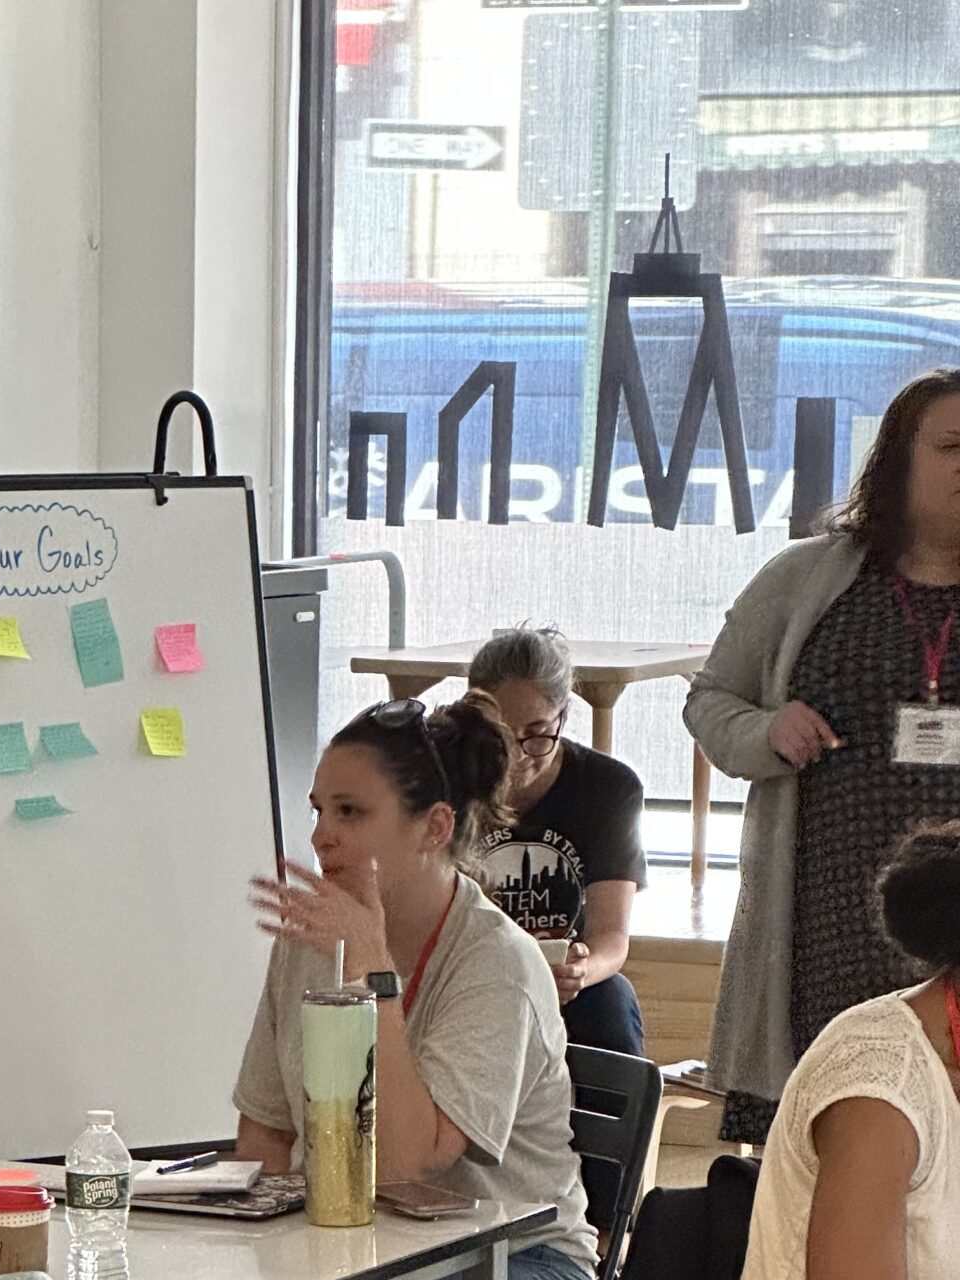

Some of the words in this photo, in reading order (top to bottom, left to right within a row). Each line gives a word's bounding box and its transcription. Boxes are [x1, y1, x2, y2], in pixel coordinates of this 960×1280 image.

[37, 525, 104, 572] Goals
[543, 829, 563, 845] BY
[491, 888, 550, 913] STEM
[513, 910, 568, 929] chers
[83, 1177, 117, 1194] Poland
[84, 1187, 119, 1204] Spring
